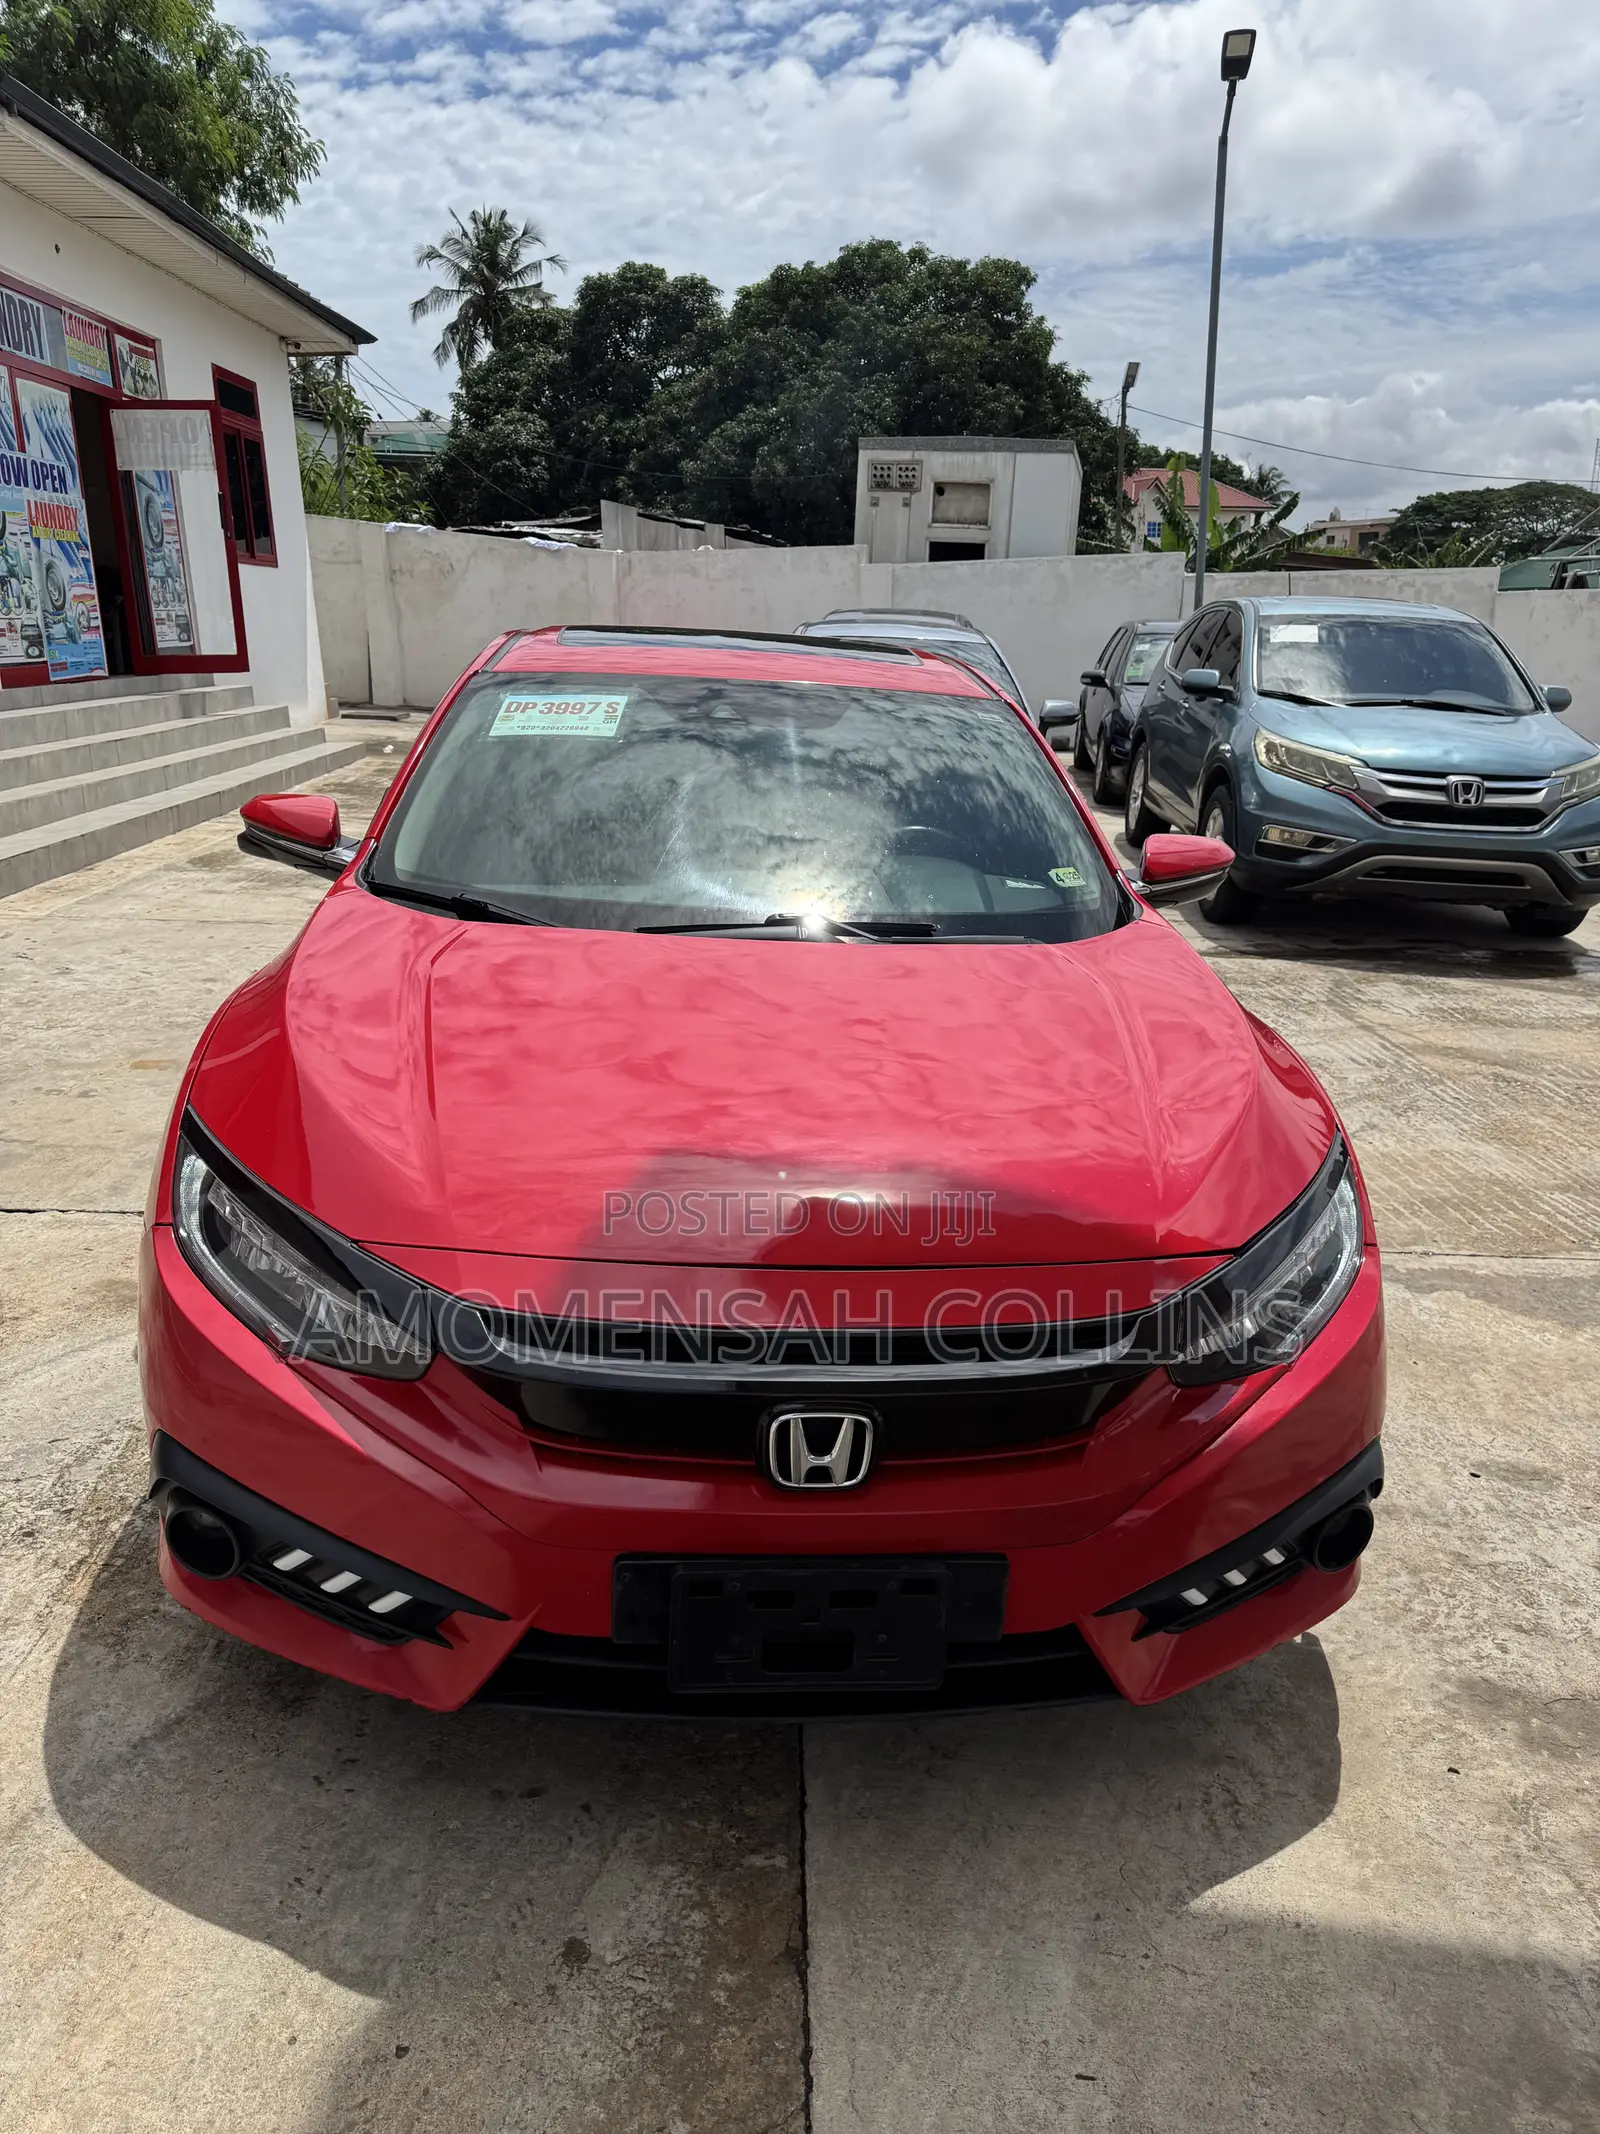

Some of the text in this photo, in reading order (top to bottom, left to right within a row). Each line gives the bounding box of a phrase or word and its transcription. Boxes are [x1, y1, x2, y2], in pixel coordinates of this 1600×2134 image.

[62, 310, 106, 351] LAUNDRY
[0, 453, 68, 495] OW OPEN
[26, 499, 78, 531] LAUNDRY
[504, 701, 620, 714] DP 3997 S
